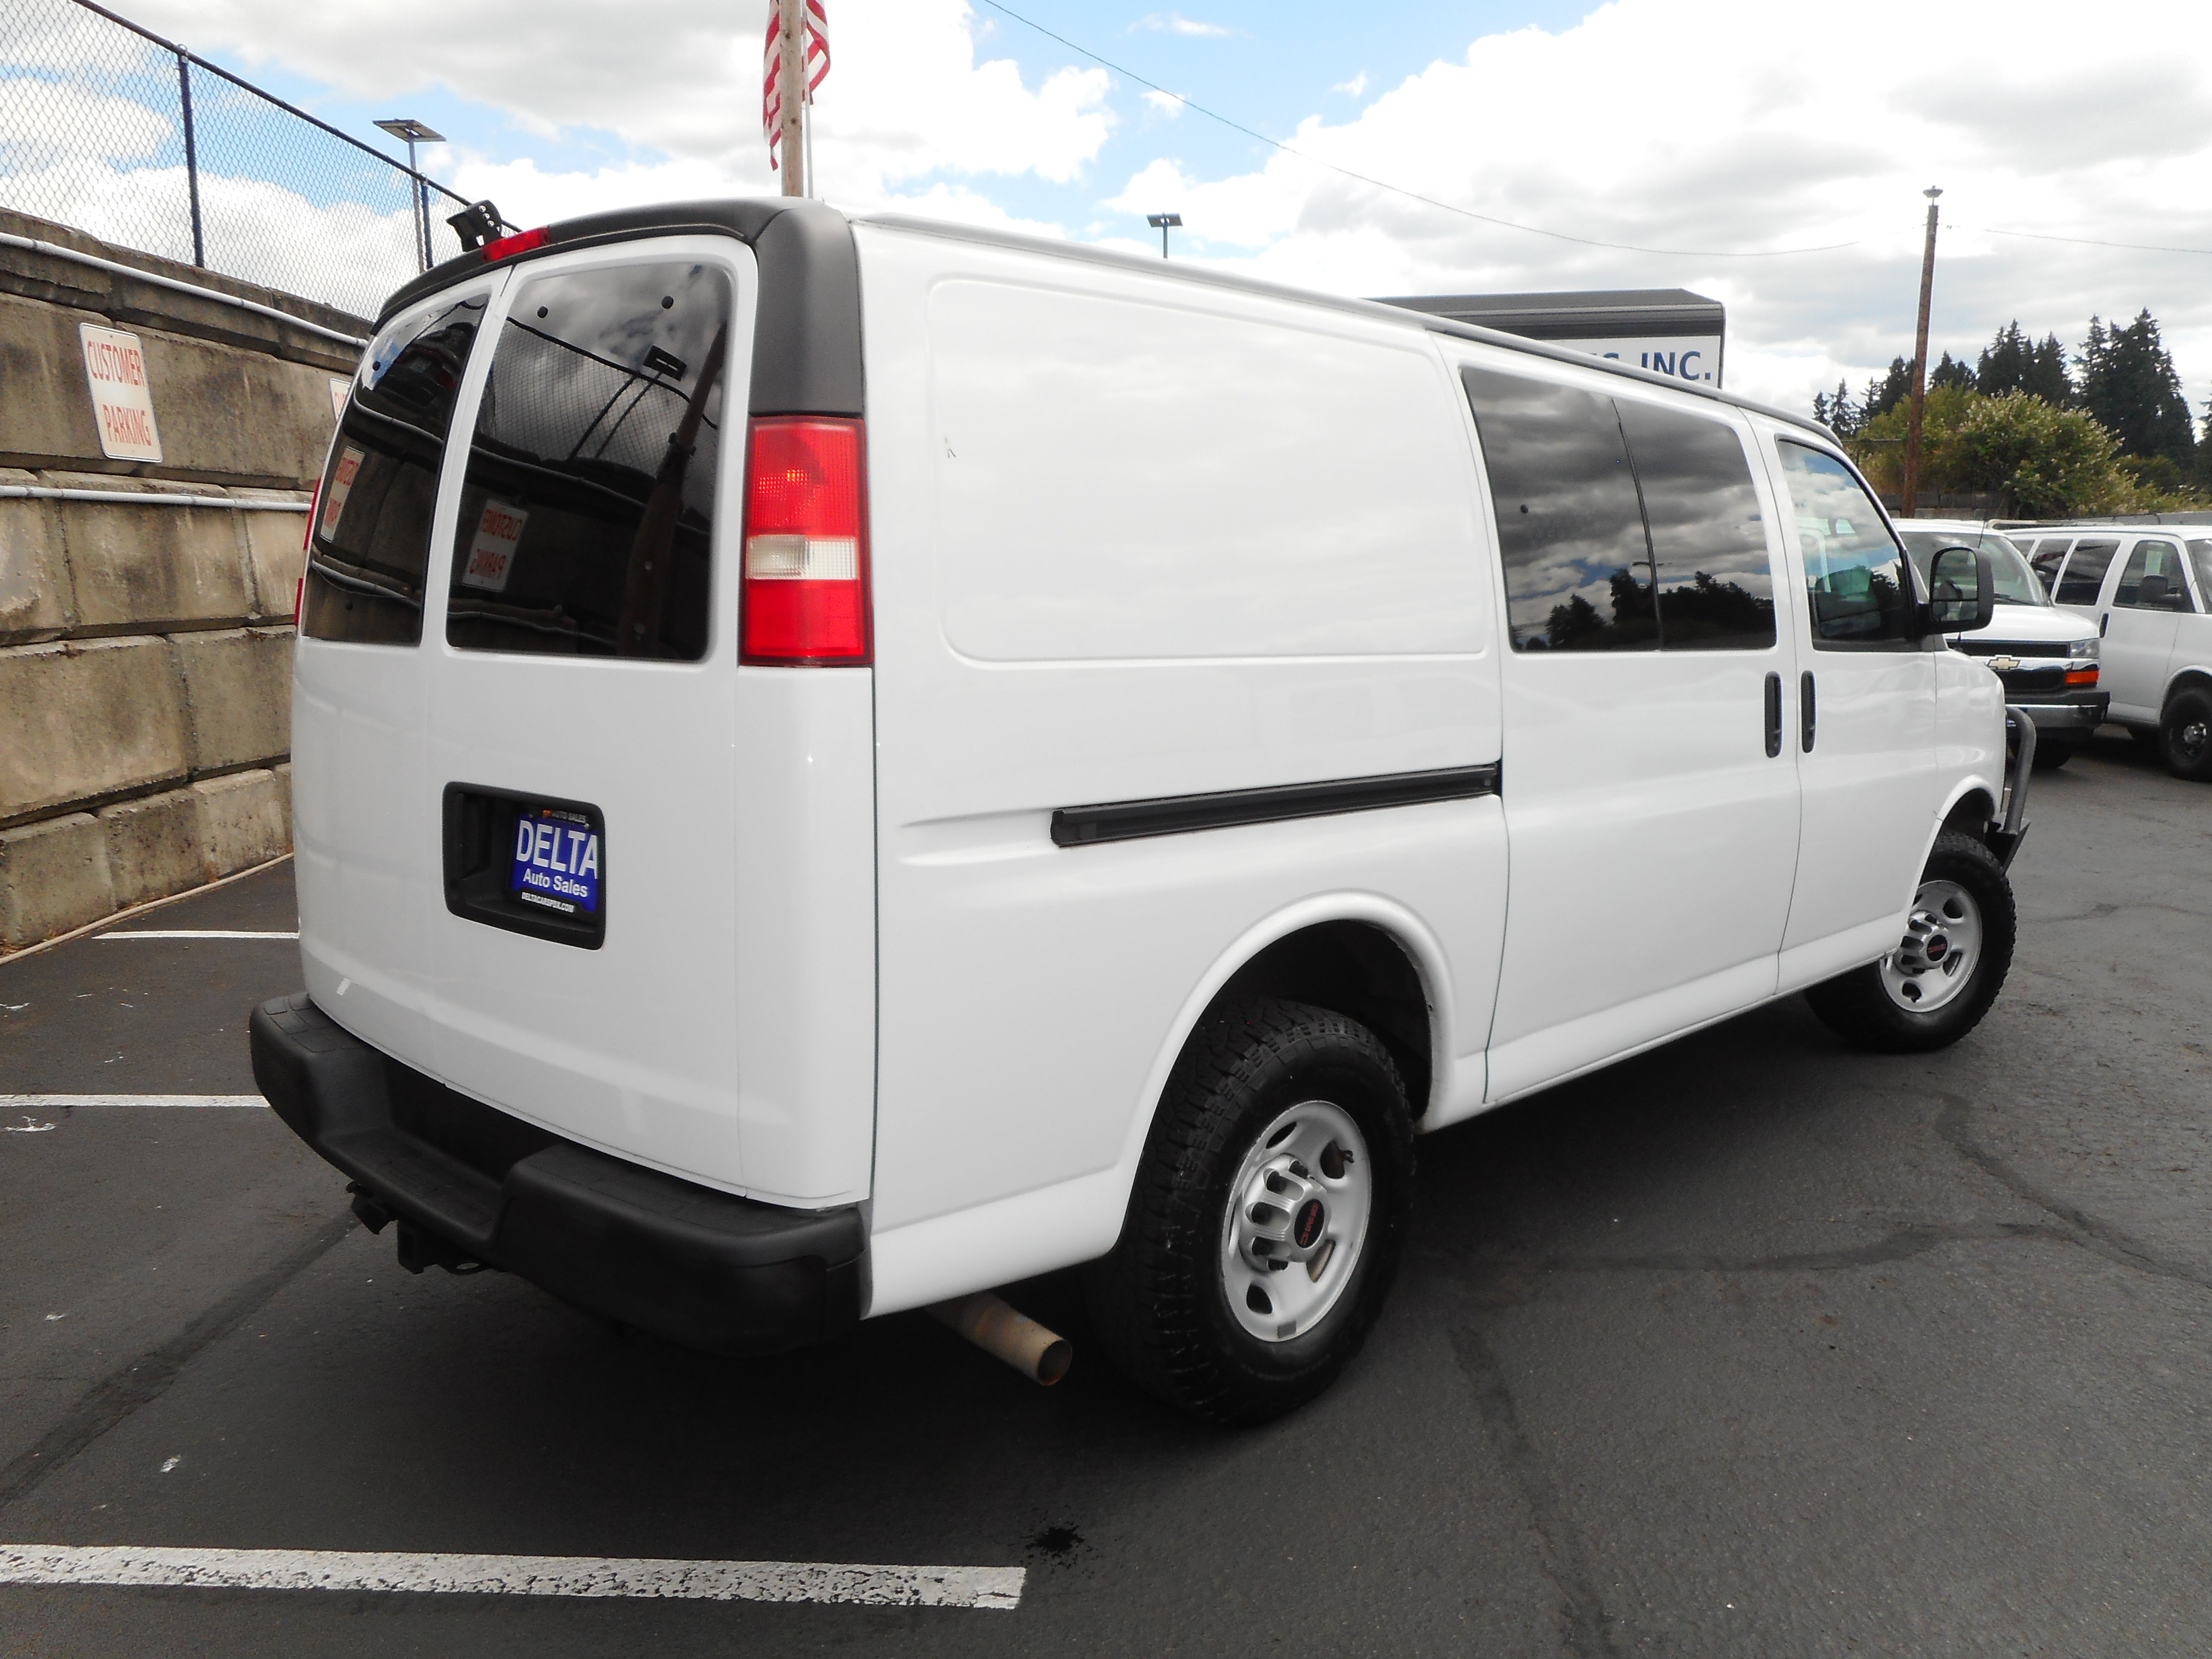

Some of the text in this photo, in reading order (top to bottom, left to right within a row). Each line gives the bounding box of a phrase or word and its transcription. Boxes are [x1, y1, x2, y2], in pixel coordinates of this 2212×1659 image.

[88, 340, 145, 386] CUSTOMER
[1641, 350, 1711, 380] INC.
[102, 404, 152, 446] PARKING
[568, 812, 586, 823] SALES
[516, 820, 597, 879] DELTA
[523, 868, 588, 897] Auto Sales
[1300, 1203, 1319, 1246] GMC
